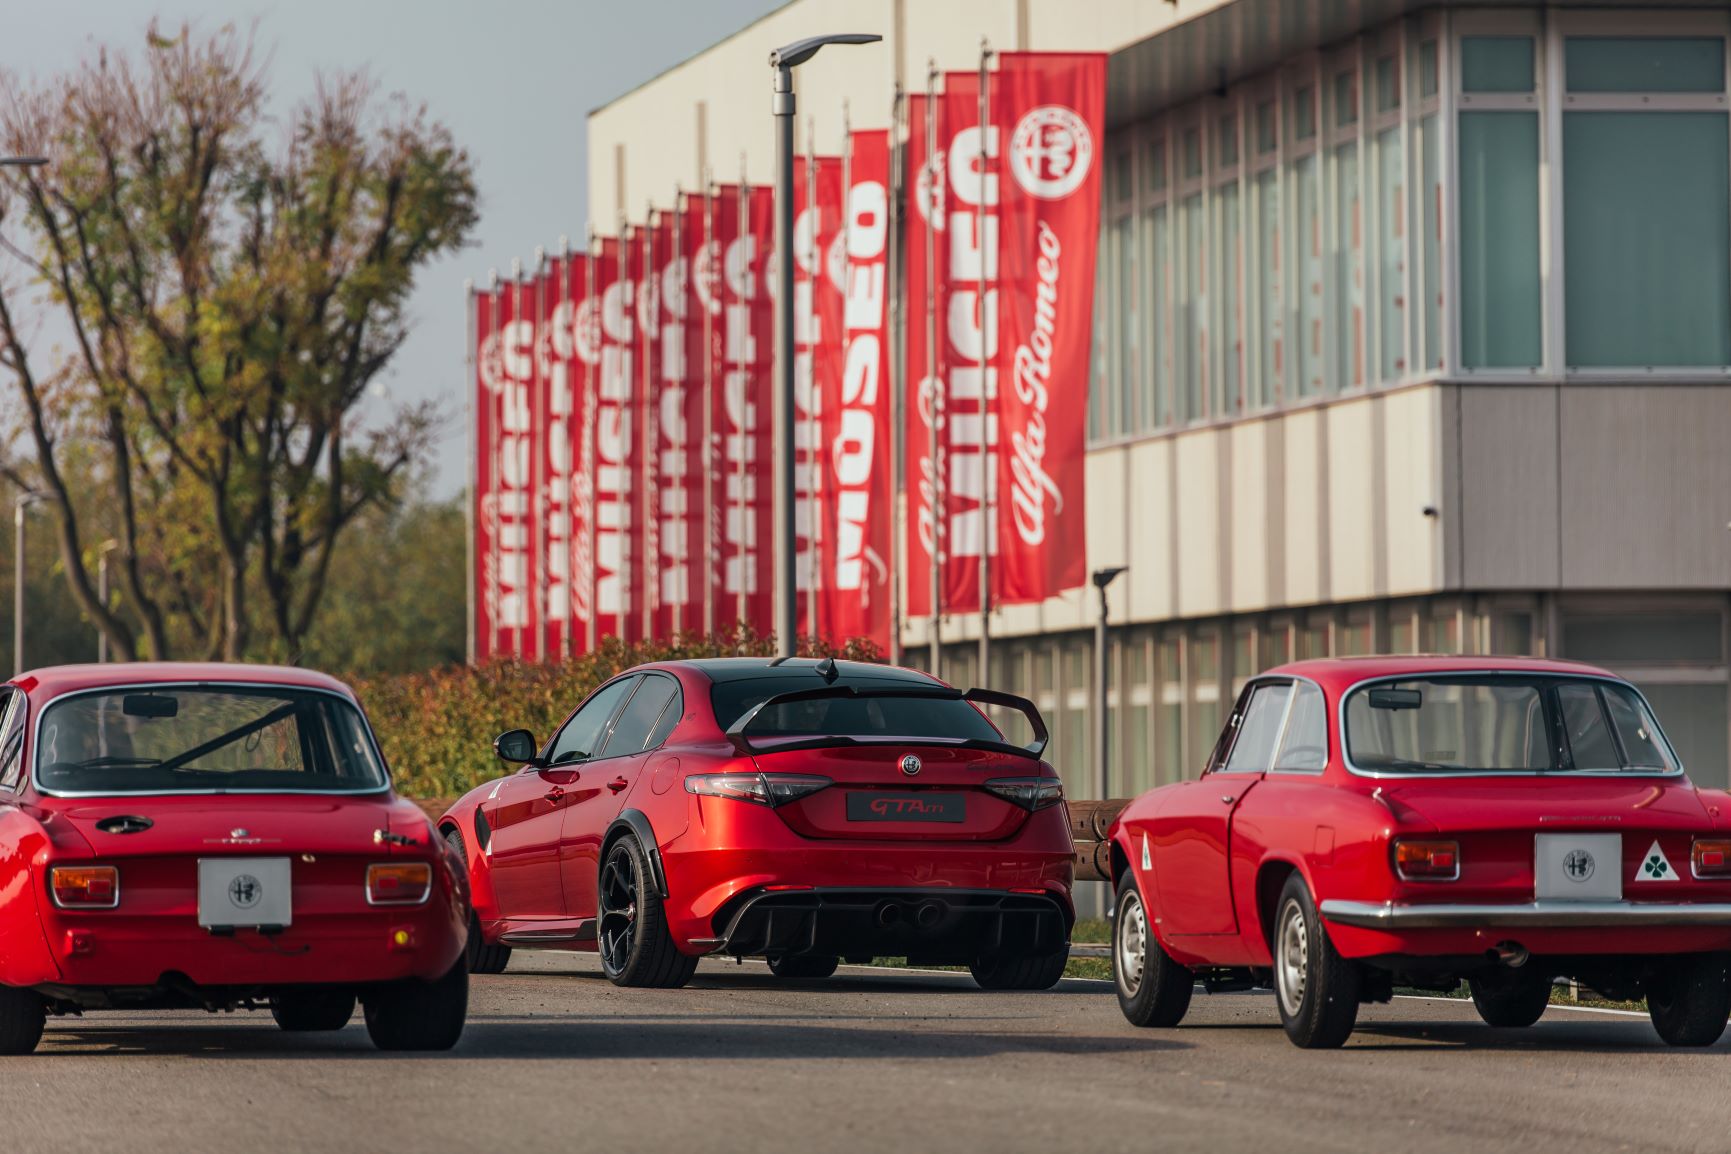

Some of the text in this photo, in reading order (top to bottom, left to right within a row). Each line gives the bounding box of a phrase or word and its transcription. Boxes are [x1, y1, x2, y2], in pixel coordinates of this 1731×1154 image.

[836, 181, 887, 590] MUSEO
[1012, 219, 1061, 411] Romeo
[1011, 411, 1064, 546] Alfa
[870, 799, 944, 816] GTAm
